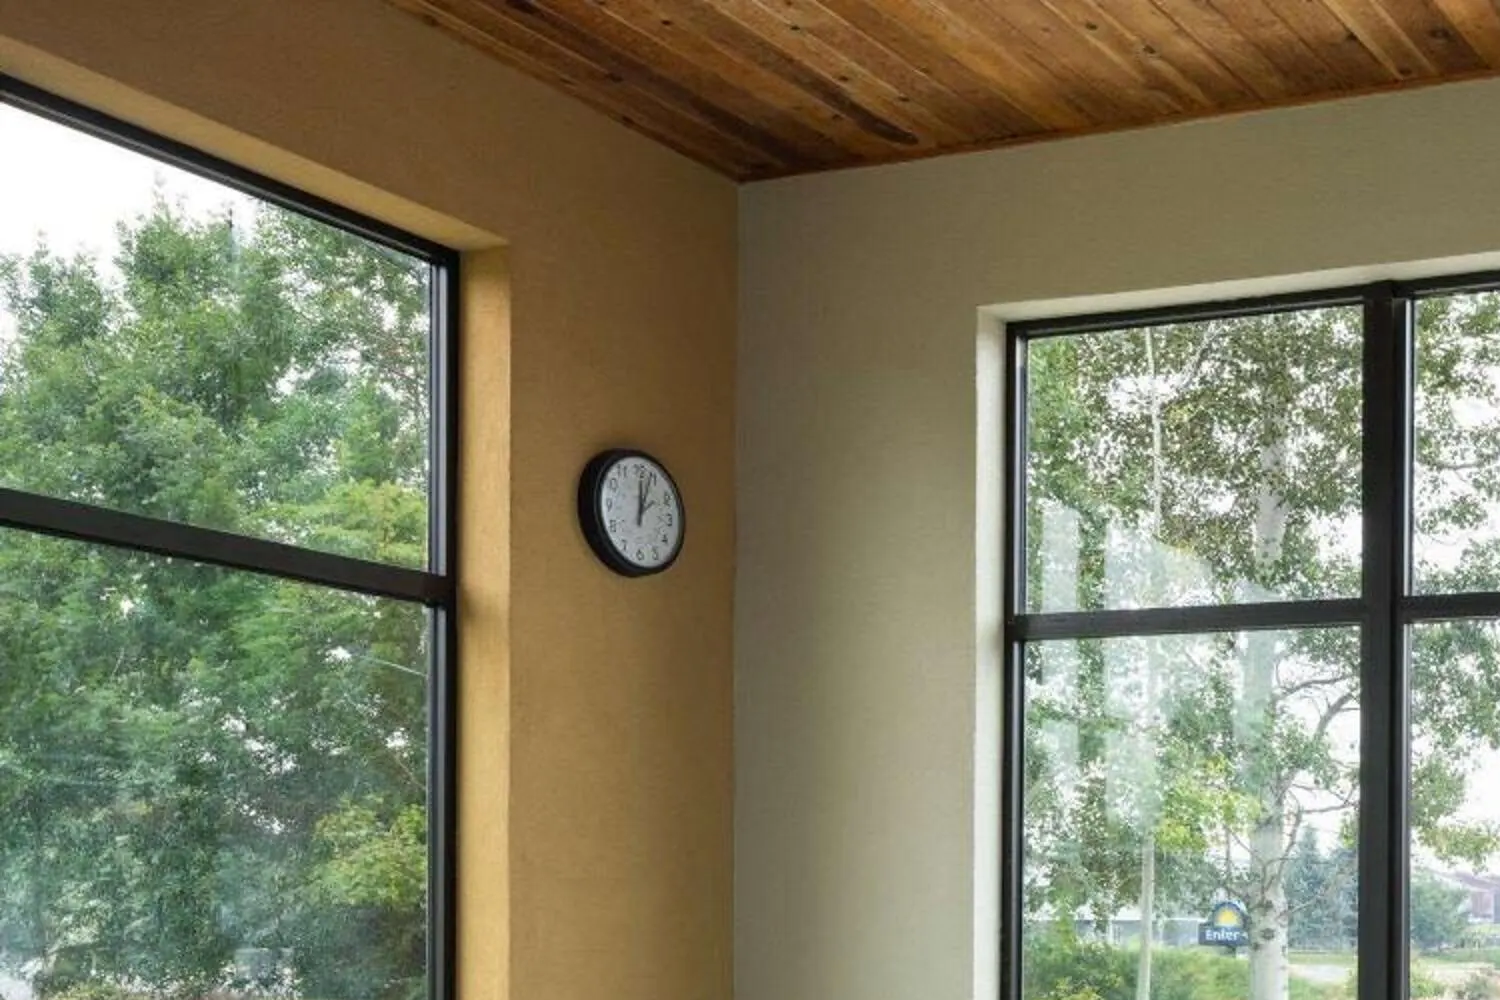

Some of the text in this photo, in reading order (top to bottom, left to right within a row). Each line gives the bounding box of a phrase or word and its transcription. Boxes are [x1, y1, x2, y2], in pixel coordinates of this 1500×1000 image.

[617, 464, 628, 478] 11
[667, 513, 674, 527] 3
[636, 549, 645, 561] 6
[1205, 928, 1240, 941] Enter
